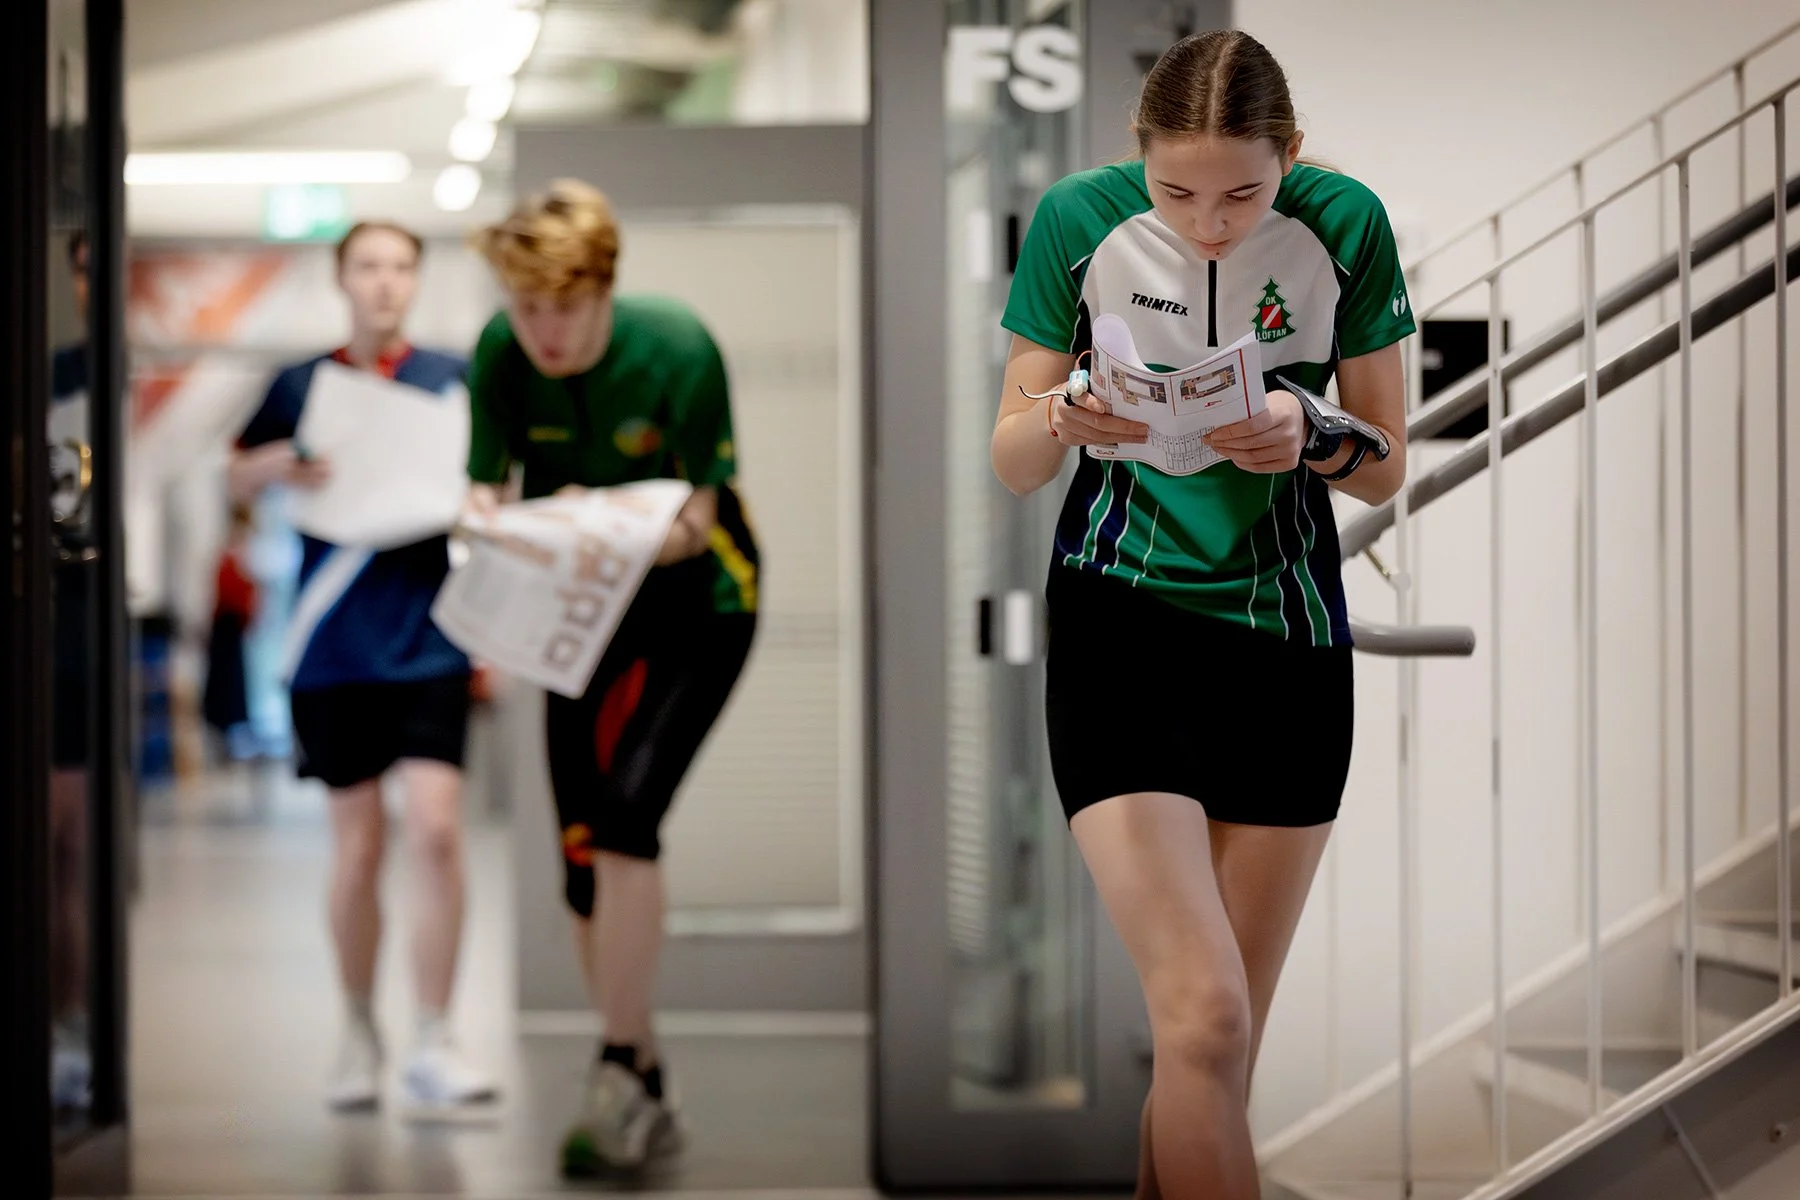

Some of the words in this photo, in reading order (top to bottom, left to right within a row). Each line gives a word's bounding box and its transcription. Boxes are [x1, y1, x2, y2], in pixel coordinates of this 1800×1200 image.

[947, 26, 1083, 113] FS
[1131, 292, 1188, 317] TRIMTEX
[1265, 296, 1276, 305] OK
